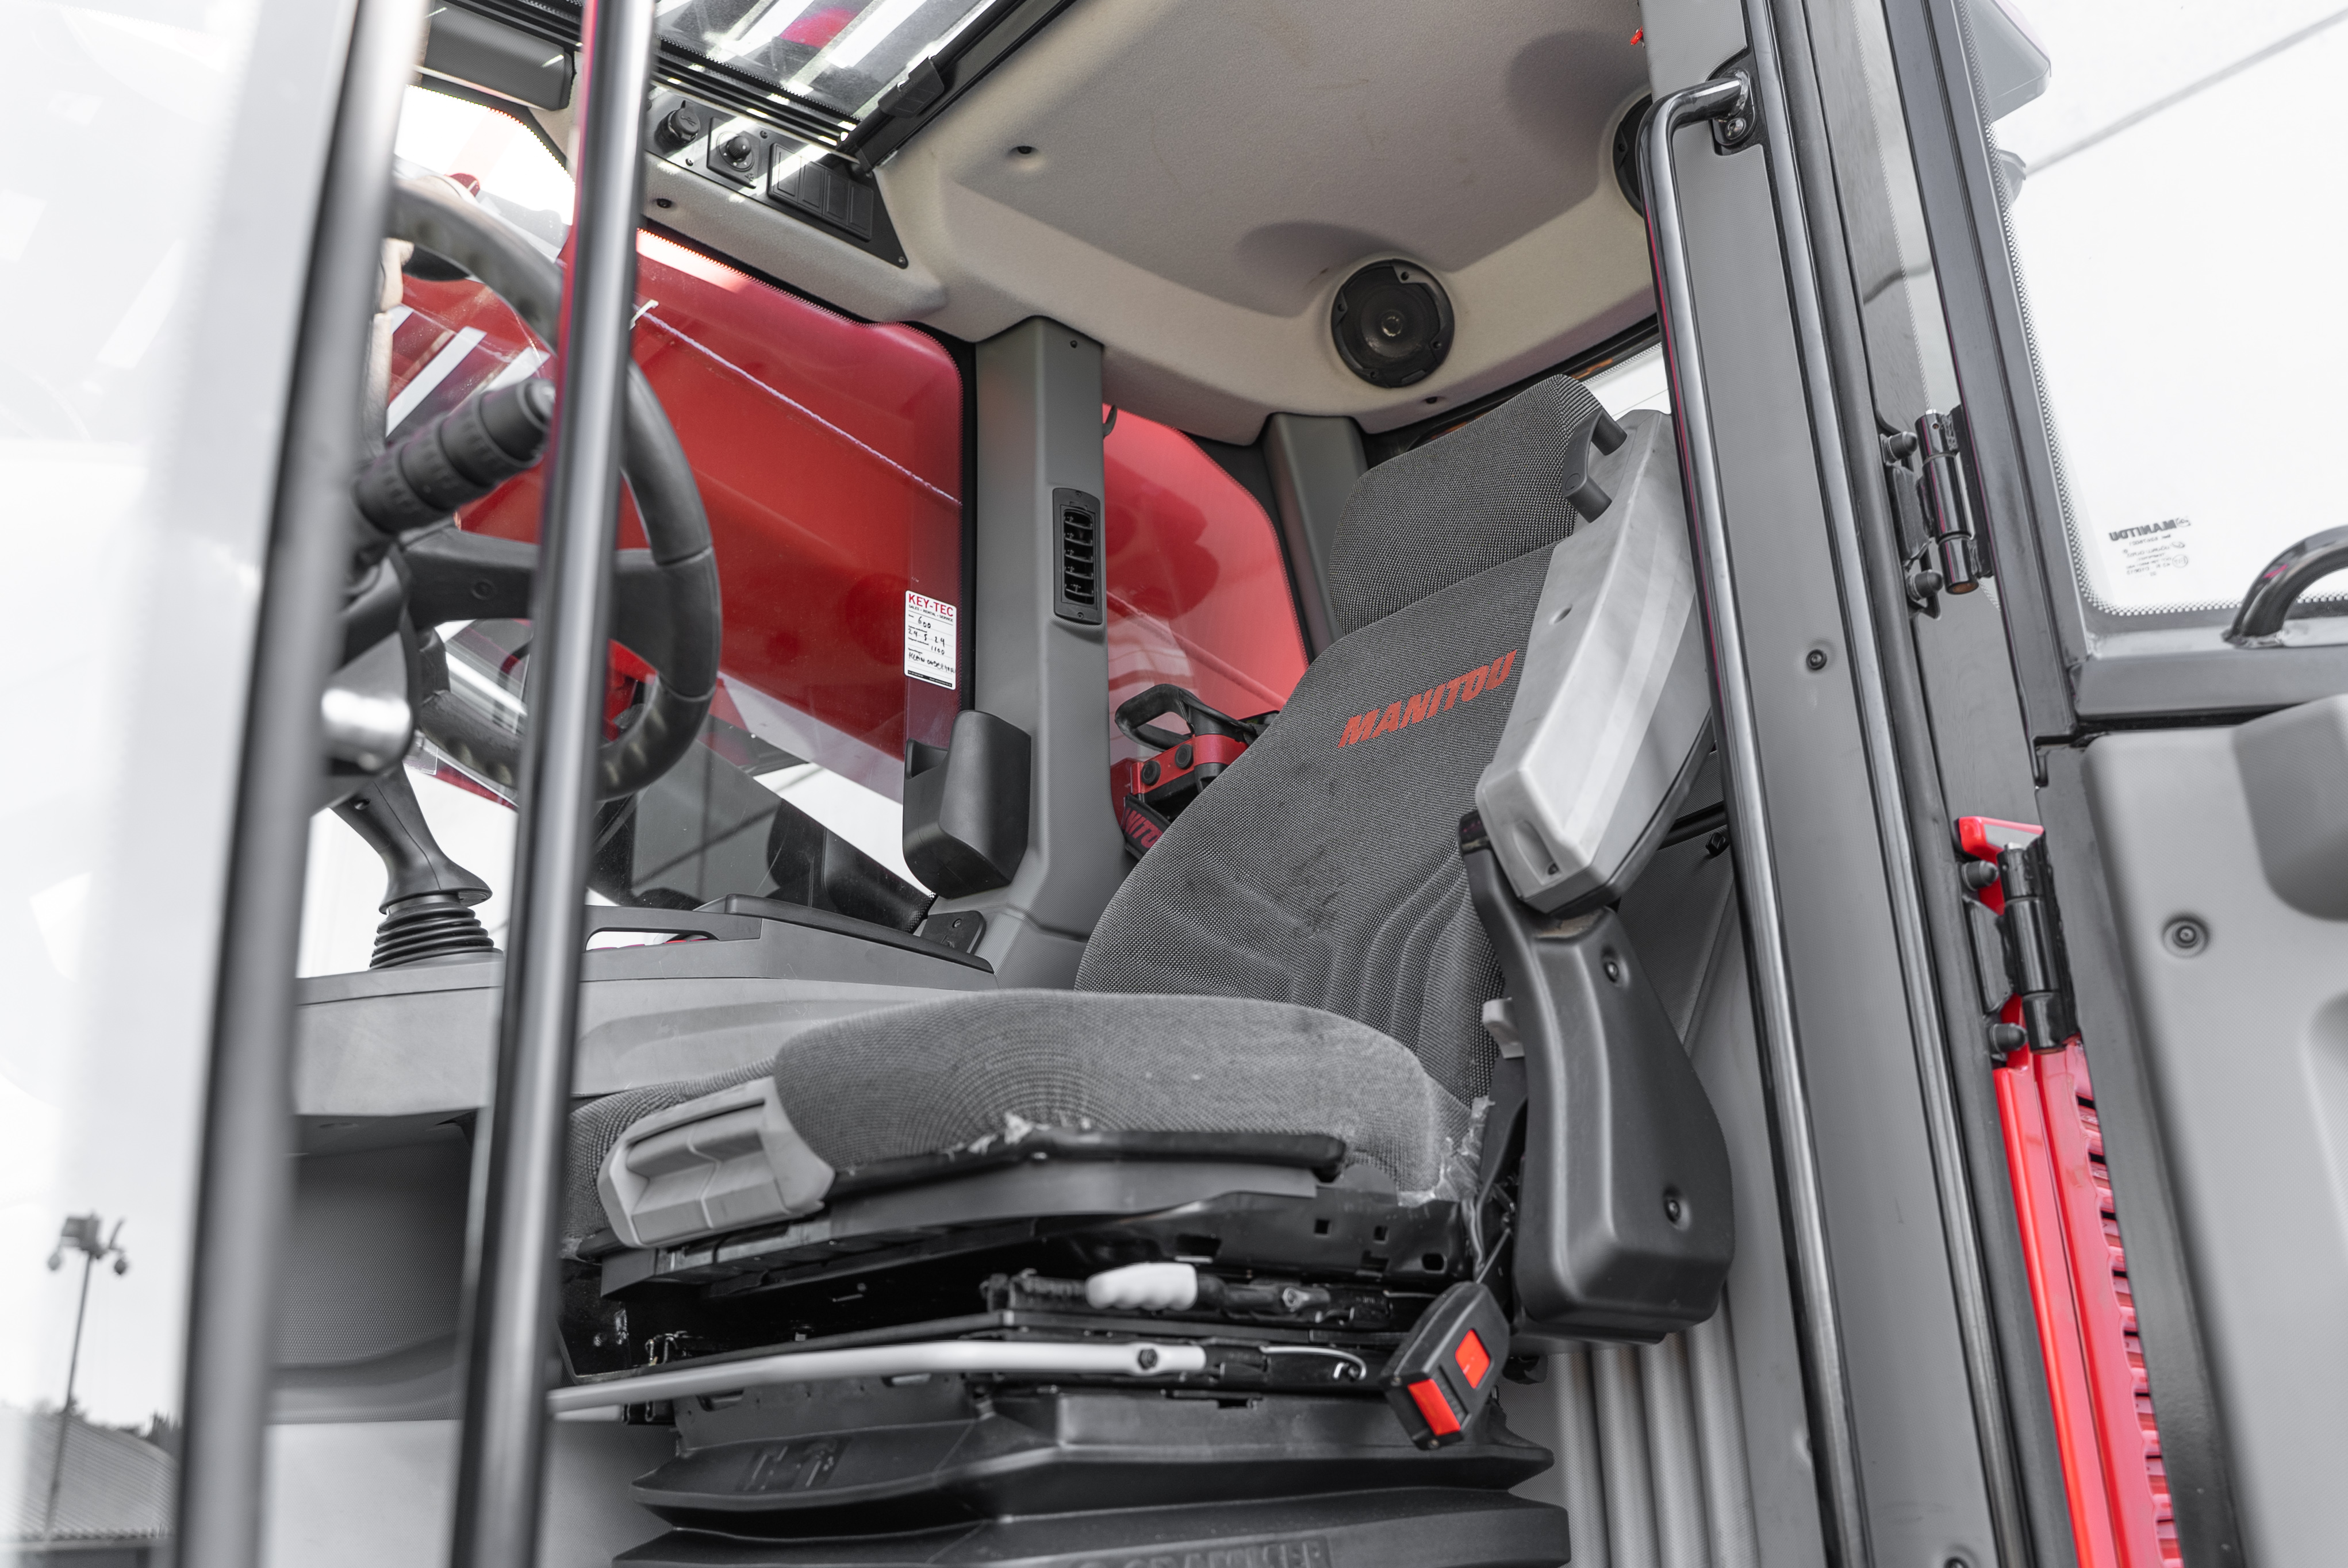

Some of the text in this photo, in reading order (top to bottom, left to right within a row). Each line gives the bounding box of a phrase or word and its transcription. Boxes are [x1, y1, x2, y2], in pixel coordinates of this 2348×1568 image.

[908, 593, 953, 617] KEY-TEC
[918, 616, 931, 629] 600
[923, 609, 937, 617] RENTAL
[939, 614, 953, 622] SERVICE
[1337, 649, 1517, 748] MANITOU
